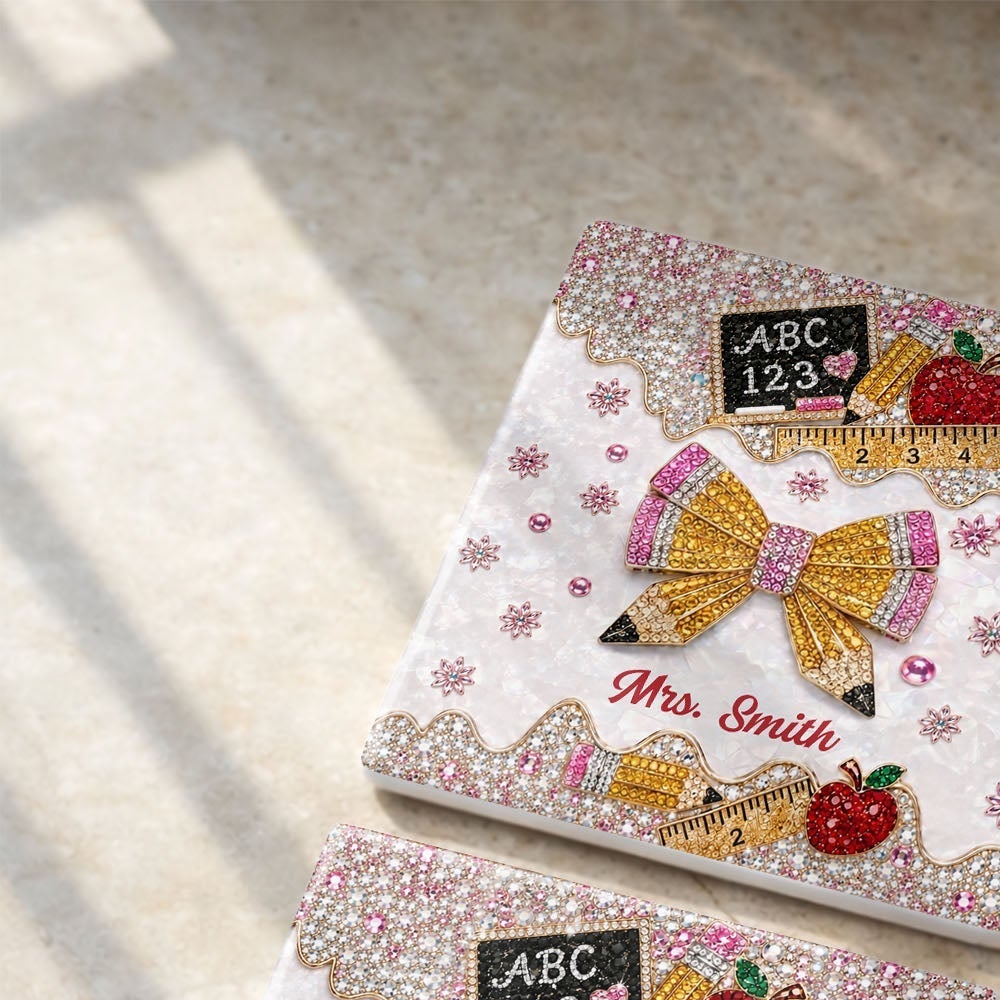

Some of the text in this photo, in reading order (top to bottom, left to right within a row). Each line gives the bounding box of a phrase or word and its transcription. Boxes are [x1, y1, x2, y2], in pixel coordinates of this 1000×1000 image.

[733, 317, 829, 355] ABC
[743, 361, 819, 395] 123
[856, 447, 971, 464] 2 3 4
[608, 669, 840, 752] Mrs. Smith
[730, 828, 745, 847] 2
[491, 943, 597, 988] ABC
